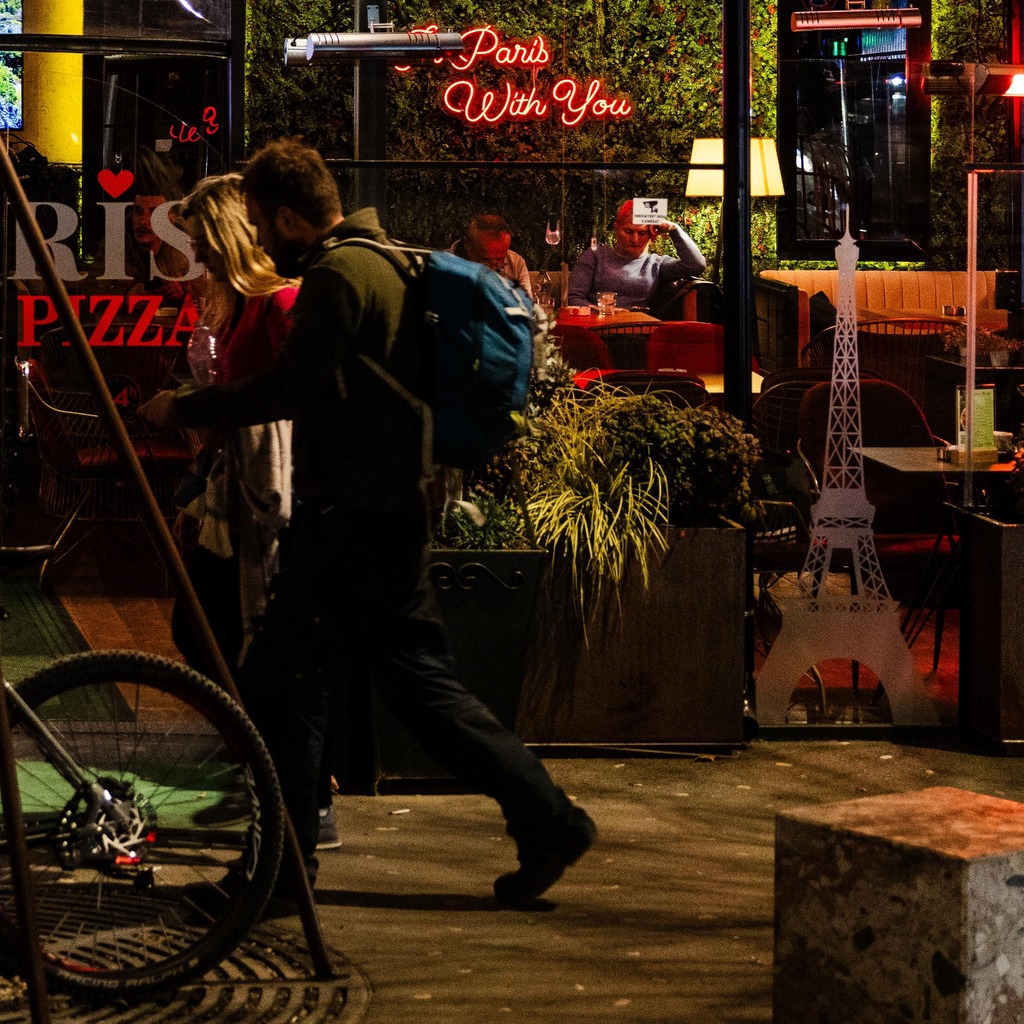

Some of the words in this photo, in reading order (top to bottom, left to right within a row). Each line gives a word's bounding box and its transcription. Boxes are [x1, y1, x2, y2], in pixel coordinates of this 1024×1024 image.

[451, 24, 549, 70] Paris
[444, 80, 546, 122] With
[552, 79, 631, 125] You
